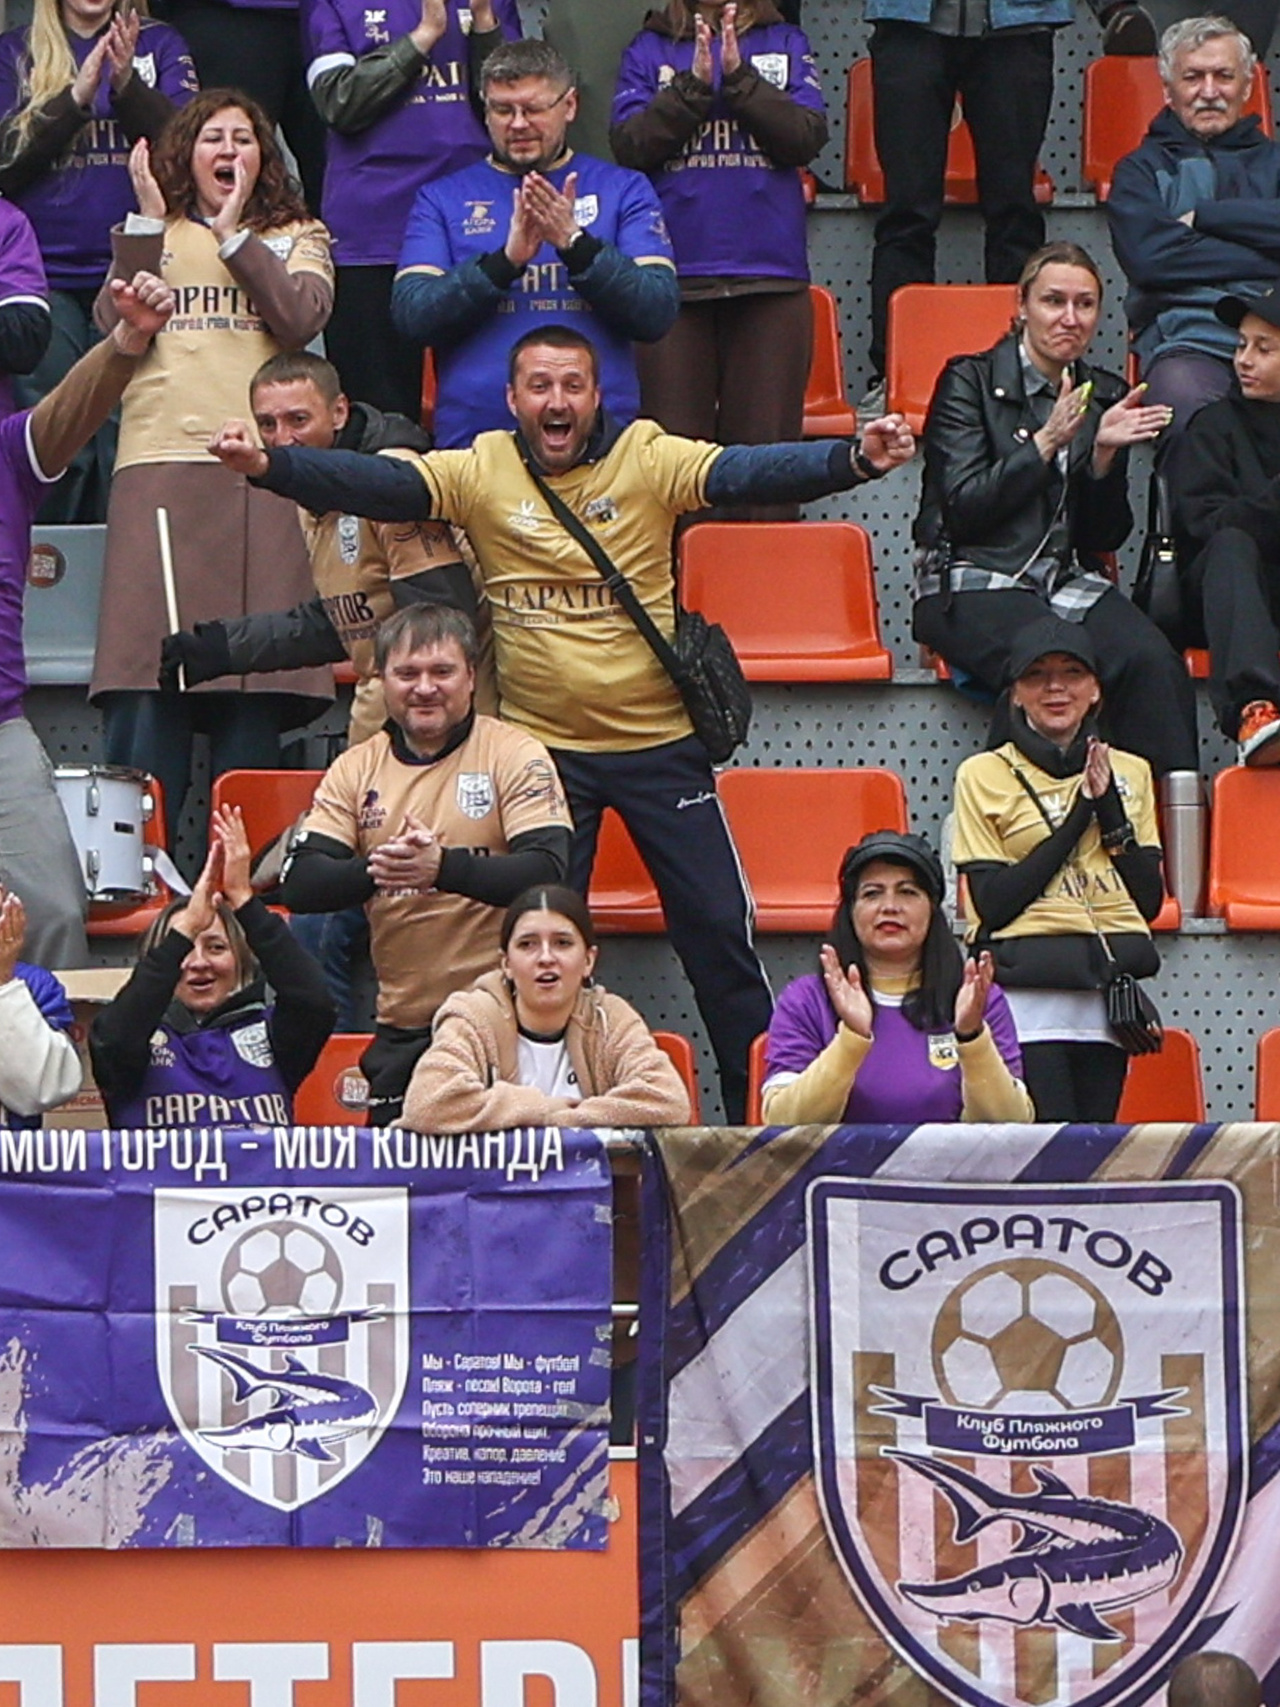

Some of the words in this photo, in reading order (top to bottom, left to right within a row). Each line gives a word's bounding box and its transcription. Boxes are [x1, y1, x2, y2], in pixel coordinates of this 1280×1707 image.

[146, 1093, 289, 1128] САРАТОВ
[187, 1193, 376, 1247] САРАТОВ
[878, 1213, 1173, 1297] САРАТОВ
[422, 1353, 443, 1370] Мы
[504, 1353, 524, 1370] Мы
[957, 1413, 1005, 1435] Клуб
[1009, 1416, 1103, 1434] Пляжного
[982, 1434, 1079, 1452] Футбола
[422, 1468, 442, 1484] Это
